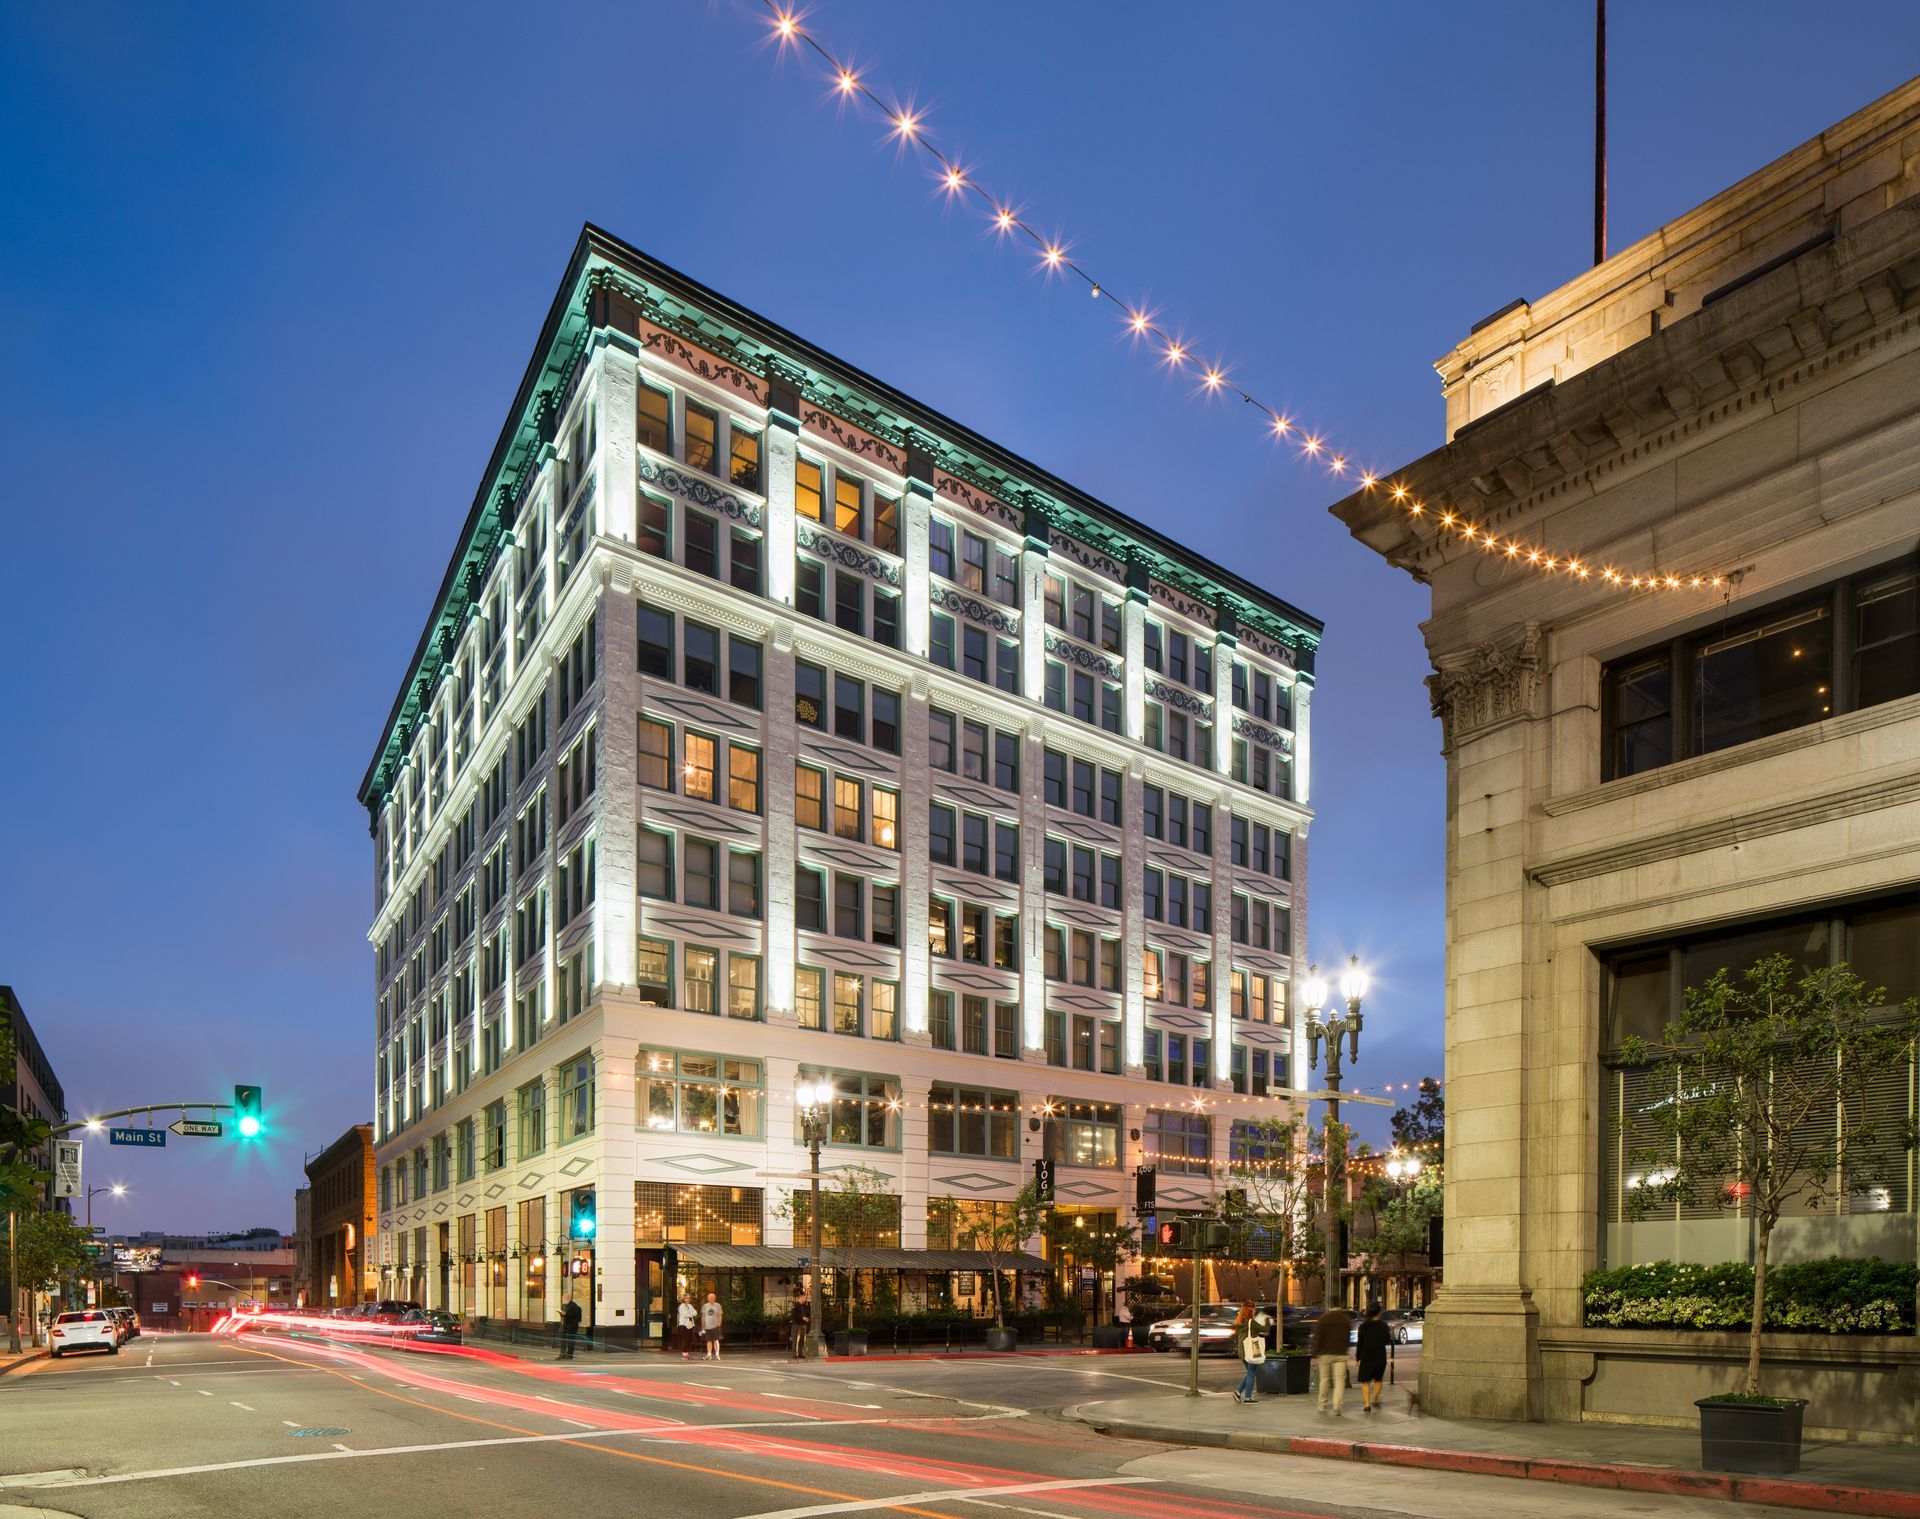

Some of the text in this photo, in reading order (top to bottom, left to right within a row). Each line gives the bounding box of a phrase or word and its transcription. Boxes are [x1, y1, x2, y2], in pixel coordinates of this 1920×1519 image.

[115, 1131, 162, 1143] Main St
[1138, 1165, 1152, 1175] 400
[1136, 1201, 1155, 1210] LOFTS
